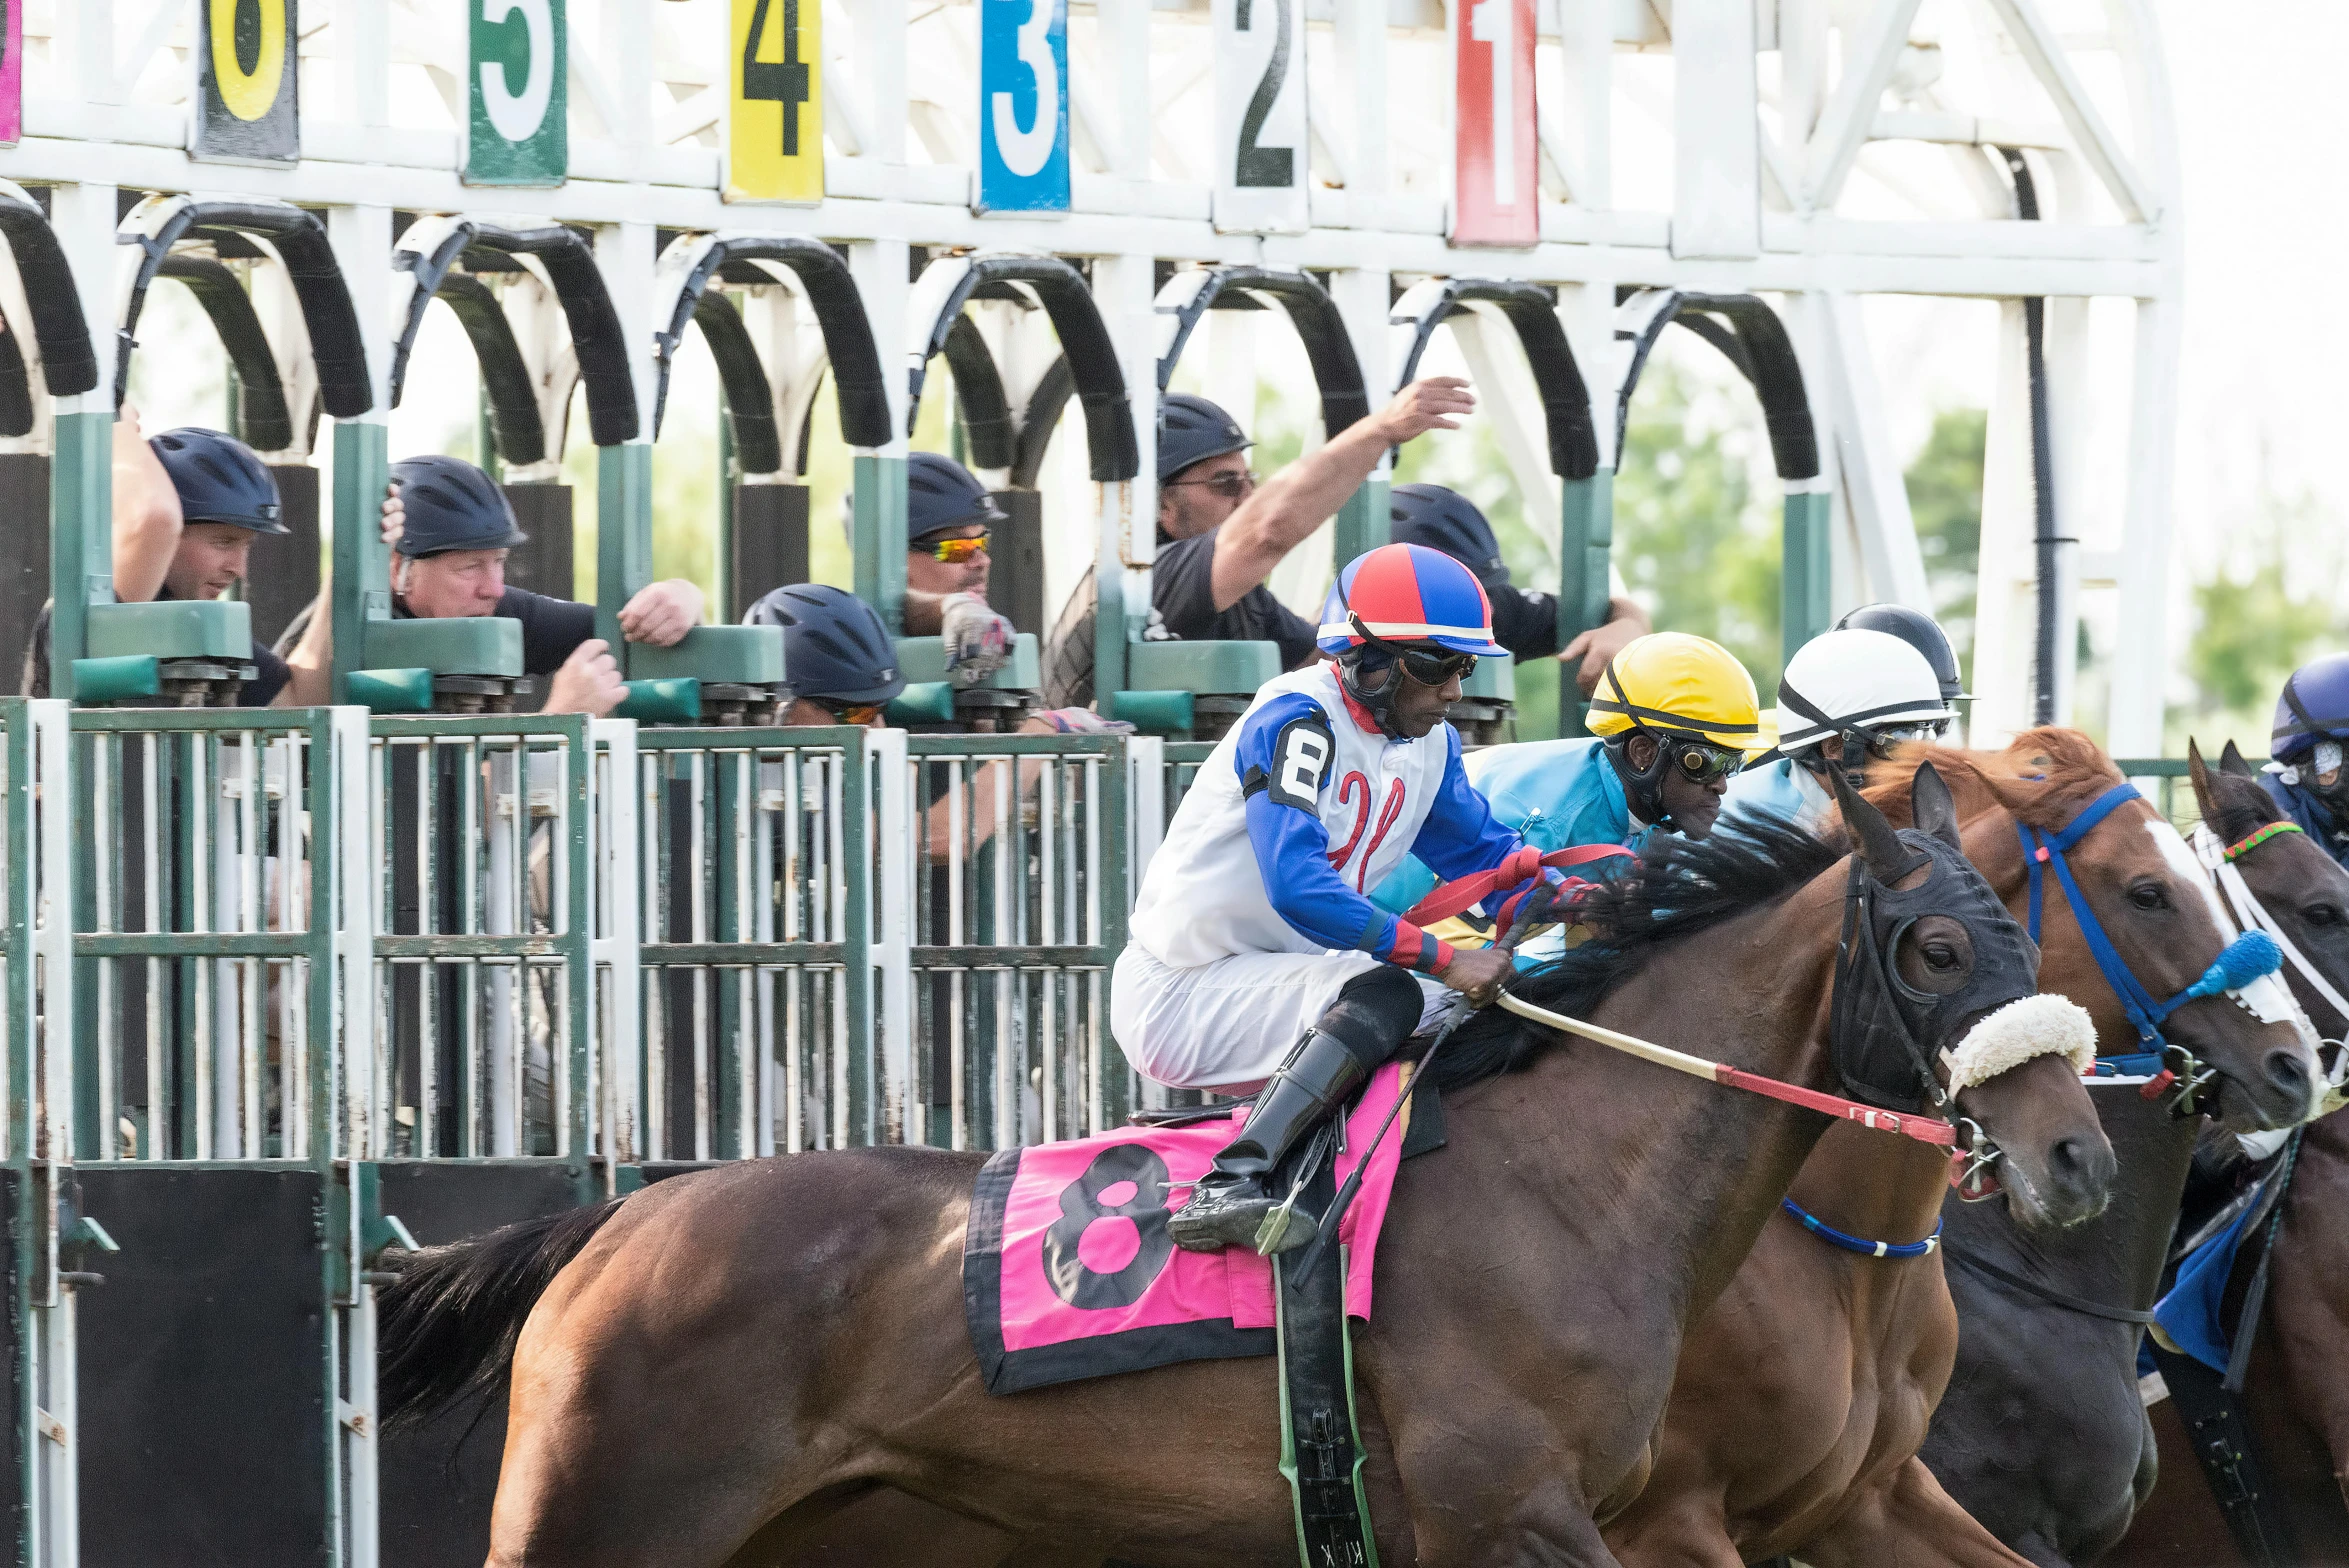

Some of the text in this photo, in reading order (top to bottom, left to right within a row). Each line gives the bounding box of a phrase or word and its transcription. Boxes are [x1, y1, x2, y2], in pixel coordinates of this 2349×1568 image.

[479, 0, 554, 142] 5
[743, 0, 809, 156] 4
[991, 0, 1059, 177] 3
[1235, 0, 1294, 187] 2
[1472, 0, 1516, 205] 1
[1280, 727, 1329, 806] 8
[1041, 1143, 1176, 1311] 8
